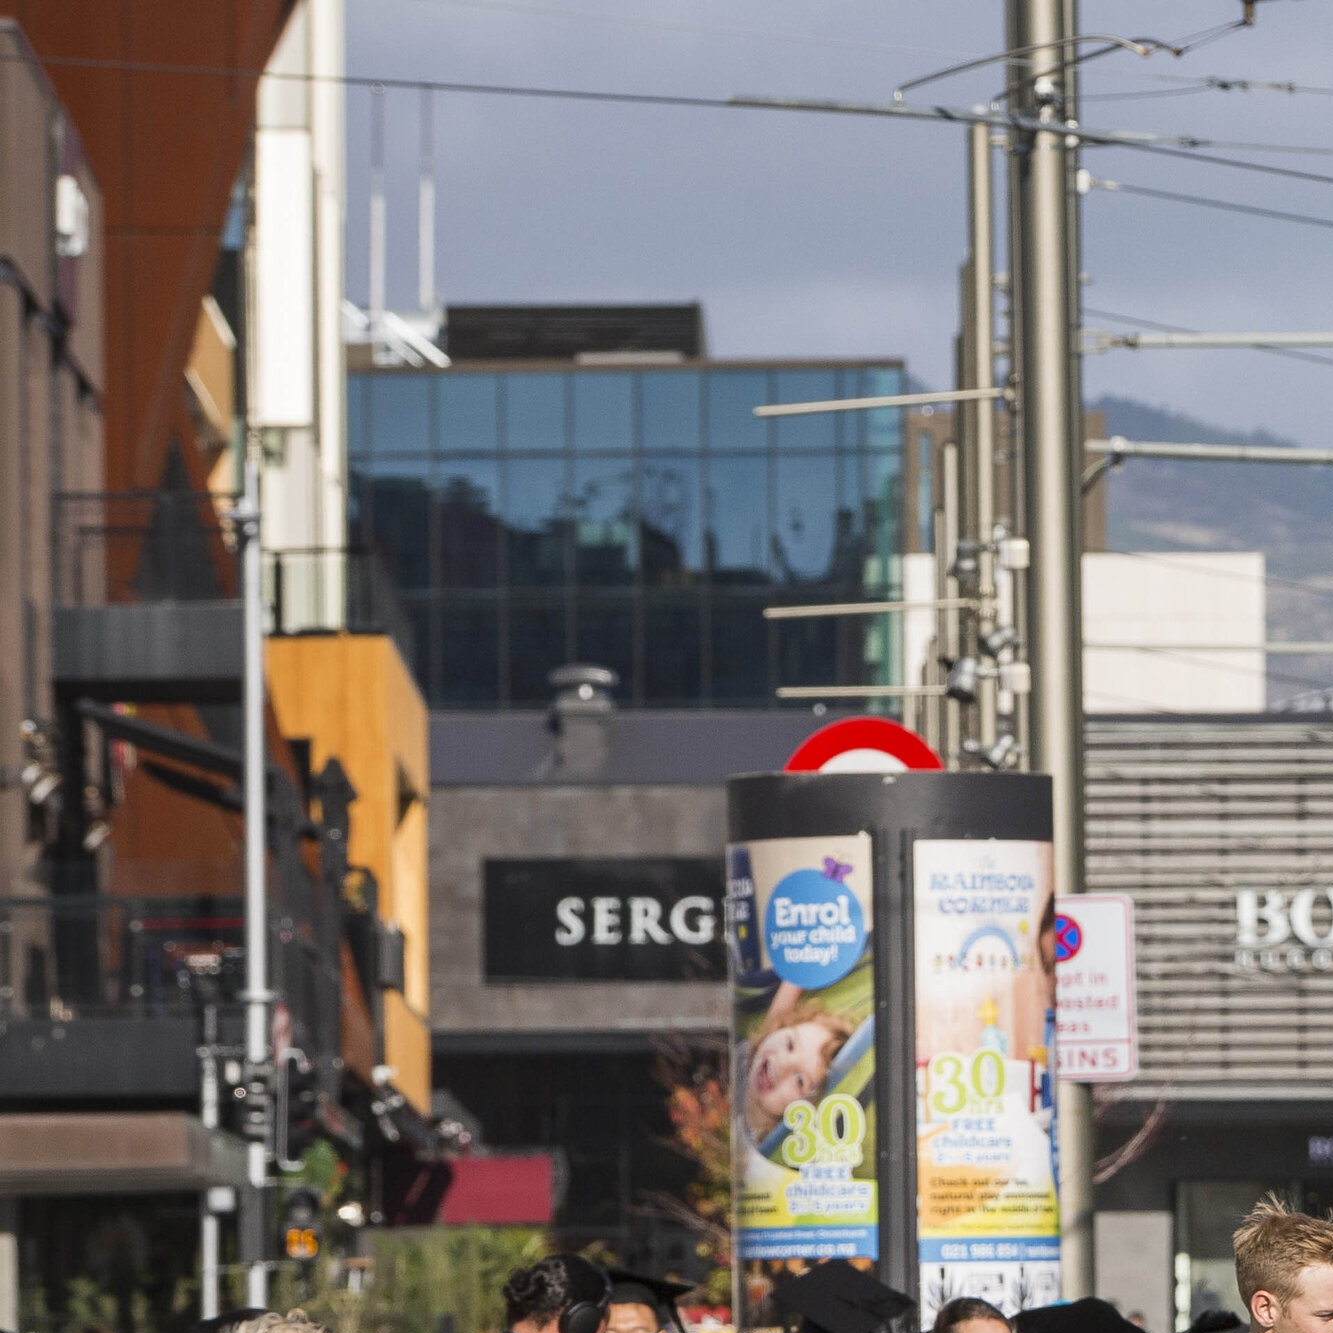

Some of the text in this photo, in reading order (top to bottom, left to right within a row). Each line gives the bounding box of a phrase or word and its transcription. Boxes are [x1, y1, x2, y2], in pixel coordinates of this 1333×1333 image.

[555, 895, 728, 946] SERG
[774, 895, 850, 927] Enrol
[770, 924, 856, 949] your child
[784, 944, 839, 967] today!
[933, 1051, 1005, 1114] 30
[783, 1094, 866, 1167] 30
